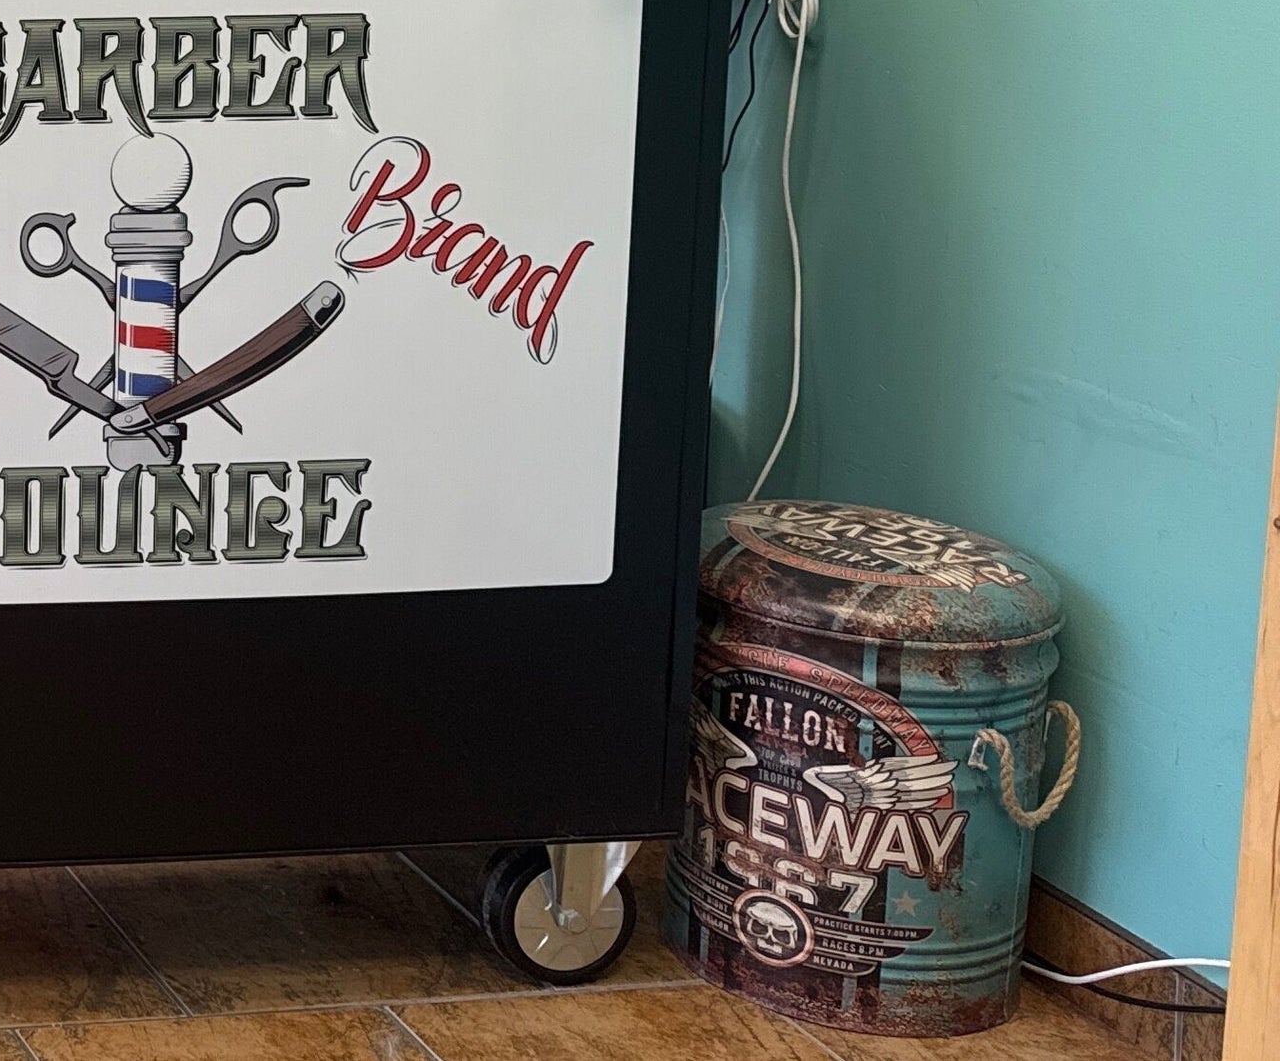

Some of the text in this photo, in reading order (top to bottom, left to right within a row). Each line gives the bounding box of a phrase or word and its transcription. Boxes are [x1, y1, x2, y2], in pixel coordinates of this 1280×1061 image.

[336, 135, 595, 365] Brand
[729, 691, 847, 754] FALLON
[743, 673, 766, 687] THIS
[768, 675, 810, 700] ACTION
[813, 691, 858, 723] PACKED
[809, 667, 933, 756] SPEEDWAY
[685, 753, 970, 878] ACEWAY
[814, 916, 853, 932] PRACTICE
[855, 924, 885, 936] STARTS
[822, 938, 856, 952] RACES
[813, 955, 854, 971] NEVADA
